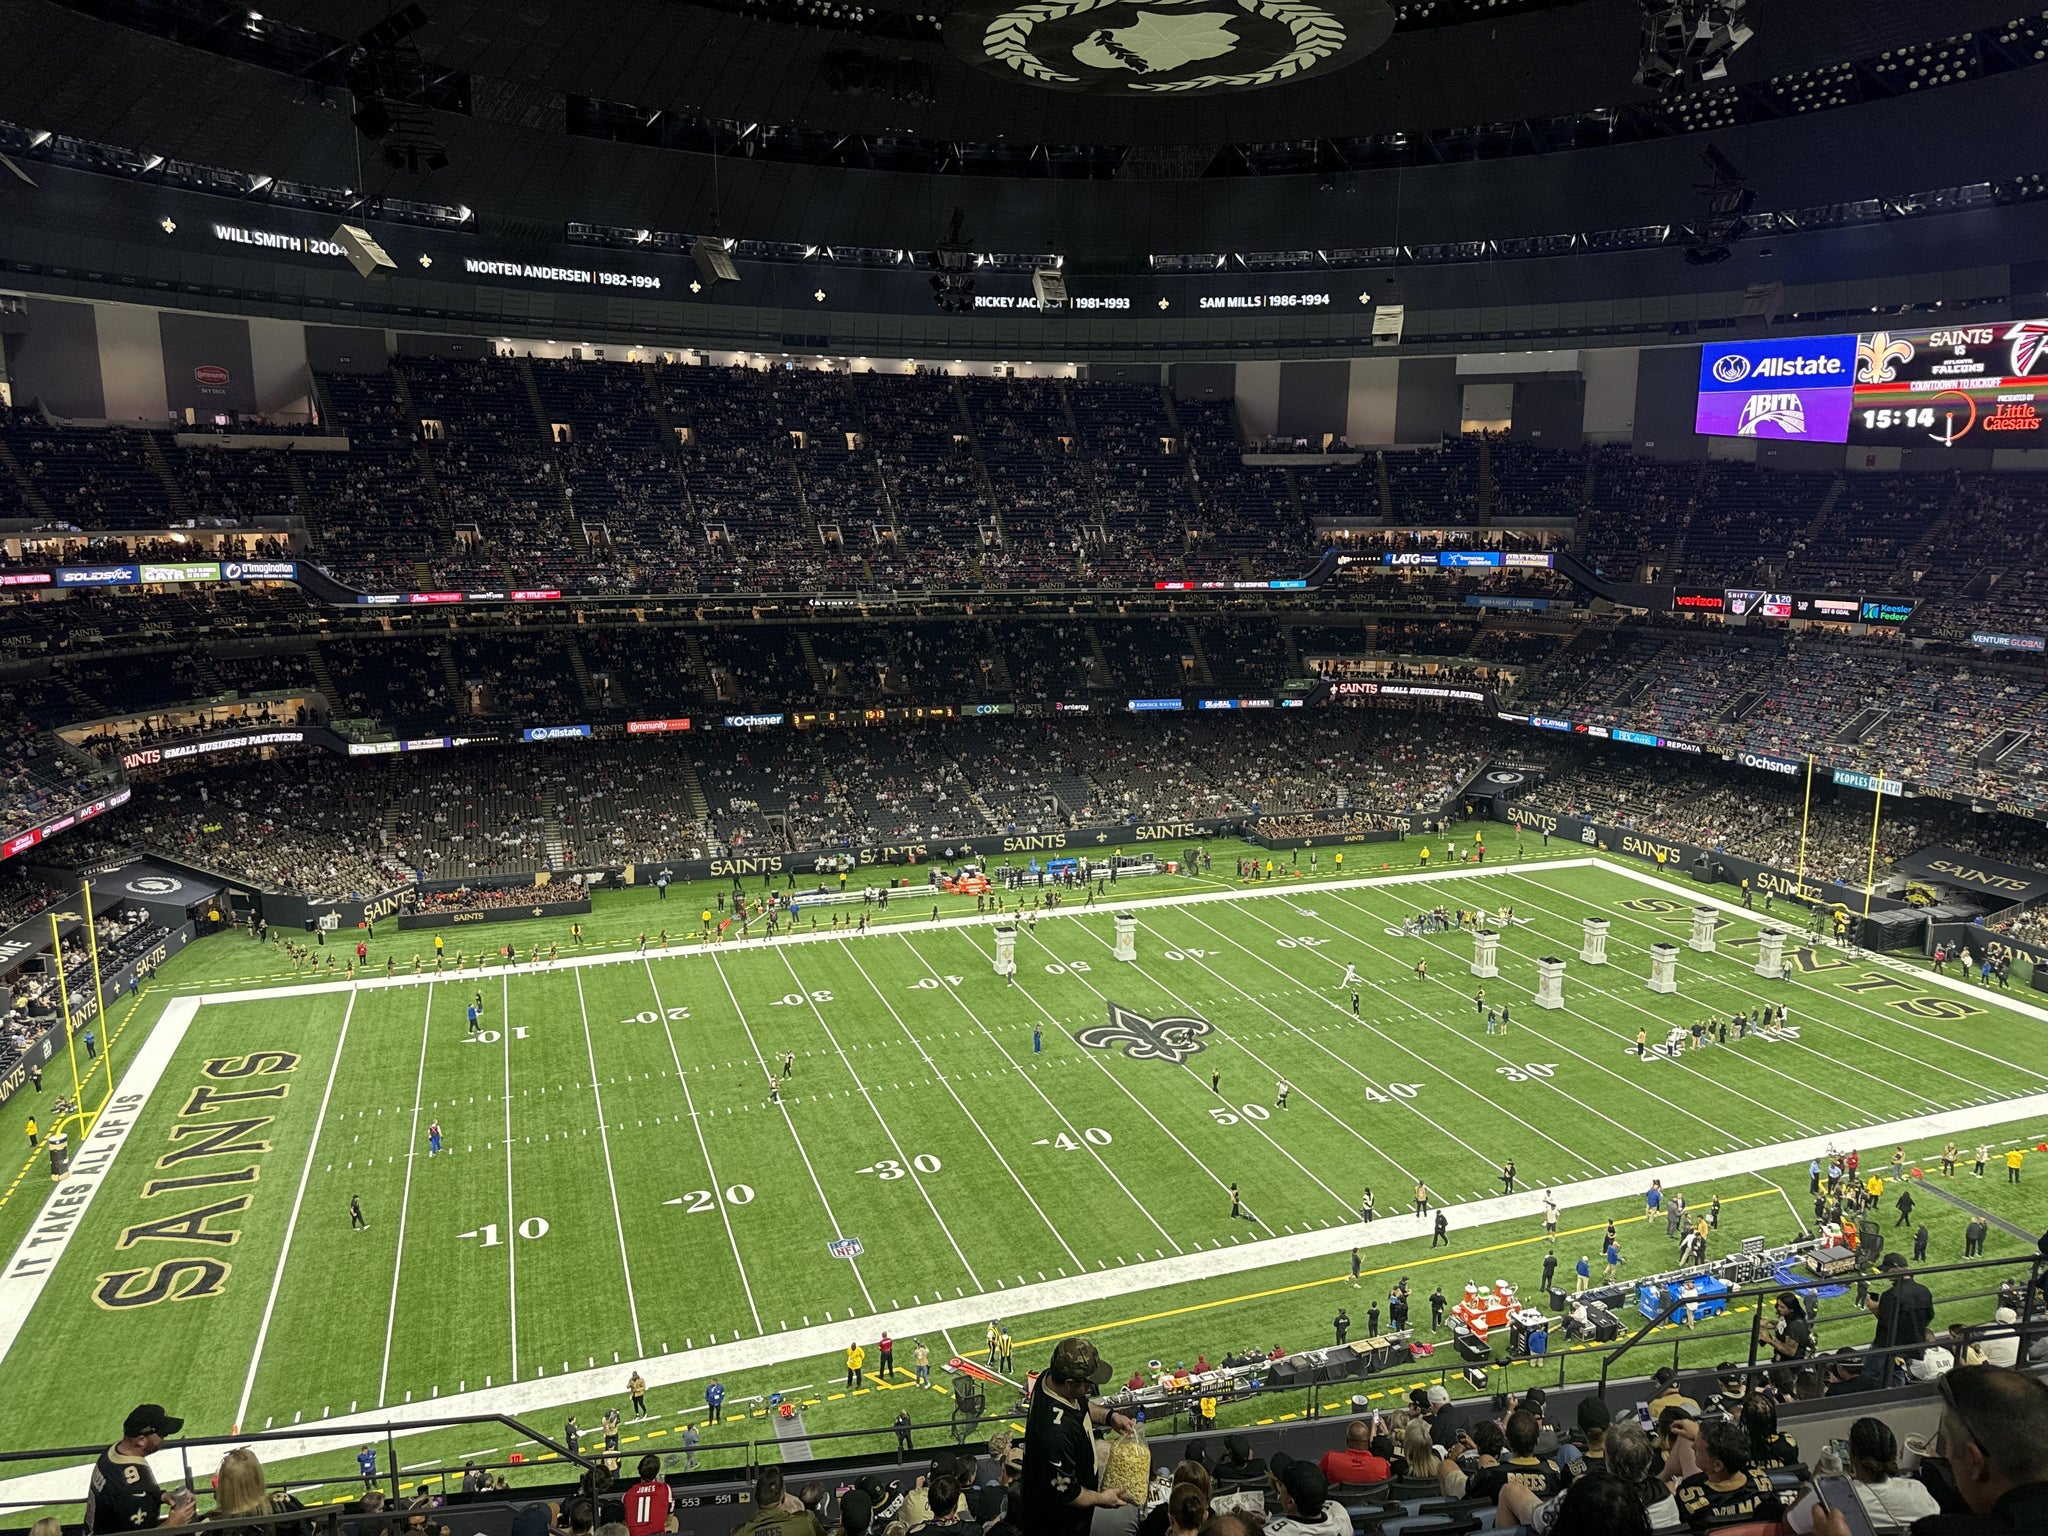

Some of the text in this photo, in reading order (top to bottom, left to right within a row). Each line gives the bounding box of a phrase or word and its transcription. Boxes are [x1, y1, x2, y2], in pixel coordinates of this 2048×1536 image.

[216, 225, 252, 243] WILL
[254, 231, 301, 251] SMITH
[466, 259, 661, 289] MORTEN ANDERSEN 1982-1994
[975, 296, 1130, 309] RICKEY 1981-1993
[1200, 293, 1330, 309] SAM MILLS 1986-1994
[1929, 329, 1994, 348] SAINTS
[1751, 355, 1842, 379] Allstate
[1932, 363, 1985, 375] FALCONS
[1910, 377, 2002, 391] COUNTDOWN TO KICKOFF
[1740, 393, 1804, 415] ABITA
[1995, 403, 2035, 418] Little
[1863, 408, 1936, 429] 15:14
[1983, 416, 2041, 431] Caesars
[1391, 553, 1420, 564] LATG
[1676, 595, 1723, 608] verizon
[1880, 603, 1912, 614] Keesler
[1880, 612, 1908, 622] Federa
[1931, 628, 1965, 639] SAINTS
[1972, 634, 2043, 649] VENTURE GLOBAL
[1339, 682, 1378, 694] SAINTS
[1380, 685, 1408, 694] SMALL
[592, 724, 624, 732] SAINTS
[630, 720, 668, 732] Community
[734, 715, 782, 727] Ochsner
[547, 727, 582, 738] Allstate
[164, 745, 198, 759] SMALL
[198, 736, 247, 753] BUSINESS
[248, 732, 303, 745] PARTNERS
[1666, 740, 1701, 753] REPDATA
[1706, 744, 1735, 757] SAINTS
[1745, 754, 1798, 775] Ochsner
[1834, 771, 1868, 787] PEOPLES
[1918, 785, 1953, 800] SAINTS
[1996, 802, 2035, 817] SAINTS
[1507, 807, 1557, 832] SAINTS
[1136, 822, 1195, 841] SAINTS
[1003, 832, 1067, 852] SAINTS
[1622, 836, 1681, 864] SAINTS
[112, 855, 144, 868] SUPERDOME
[710, 855, 783, 877] SAINTS
[1926, 860, 2031, 892] SAINTS
[364, 887, 417, 922] SAINTS
[453, 912, 484, 922] SAINTS
[1045, 960, 1092, 976] 50
[917, 973, 965, 990] 40
[782, 989, 835, 1006] 30
[634, 1006, 691, 1025] 20
[478, 1026, 531, 1045] 10
[1496, 1062, 1552, 1083] 30
[1364, 1082, 1417, 1104] 40
[1208, 1103, 1271, 1126] 50
[1053, 1126, 1114, 1152] 40
[876, 1152, 943, 1181] 30
[10, 1093, 144, 1279] IT TAKES ALL OF US
[91, 1049, 302, 1311] SAINTS
[683, 1182, 756, 1214] 20
[478, 1216, 551, 1249] 10
[1053, 1406, 1064, 1425] 7
[123, 1464, 141, 1485] 9
[636, 1484, 657, 1495] JONES
[637, 1496, 651, 1523] 11
[681, 1494, 732, 1507] 553 551
